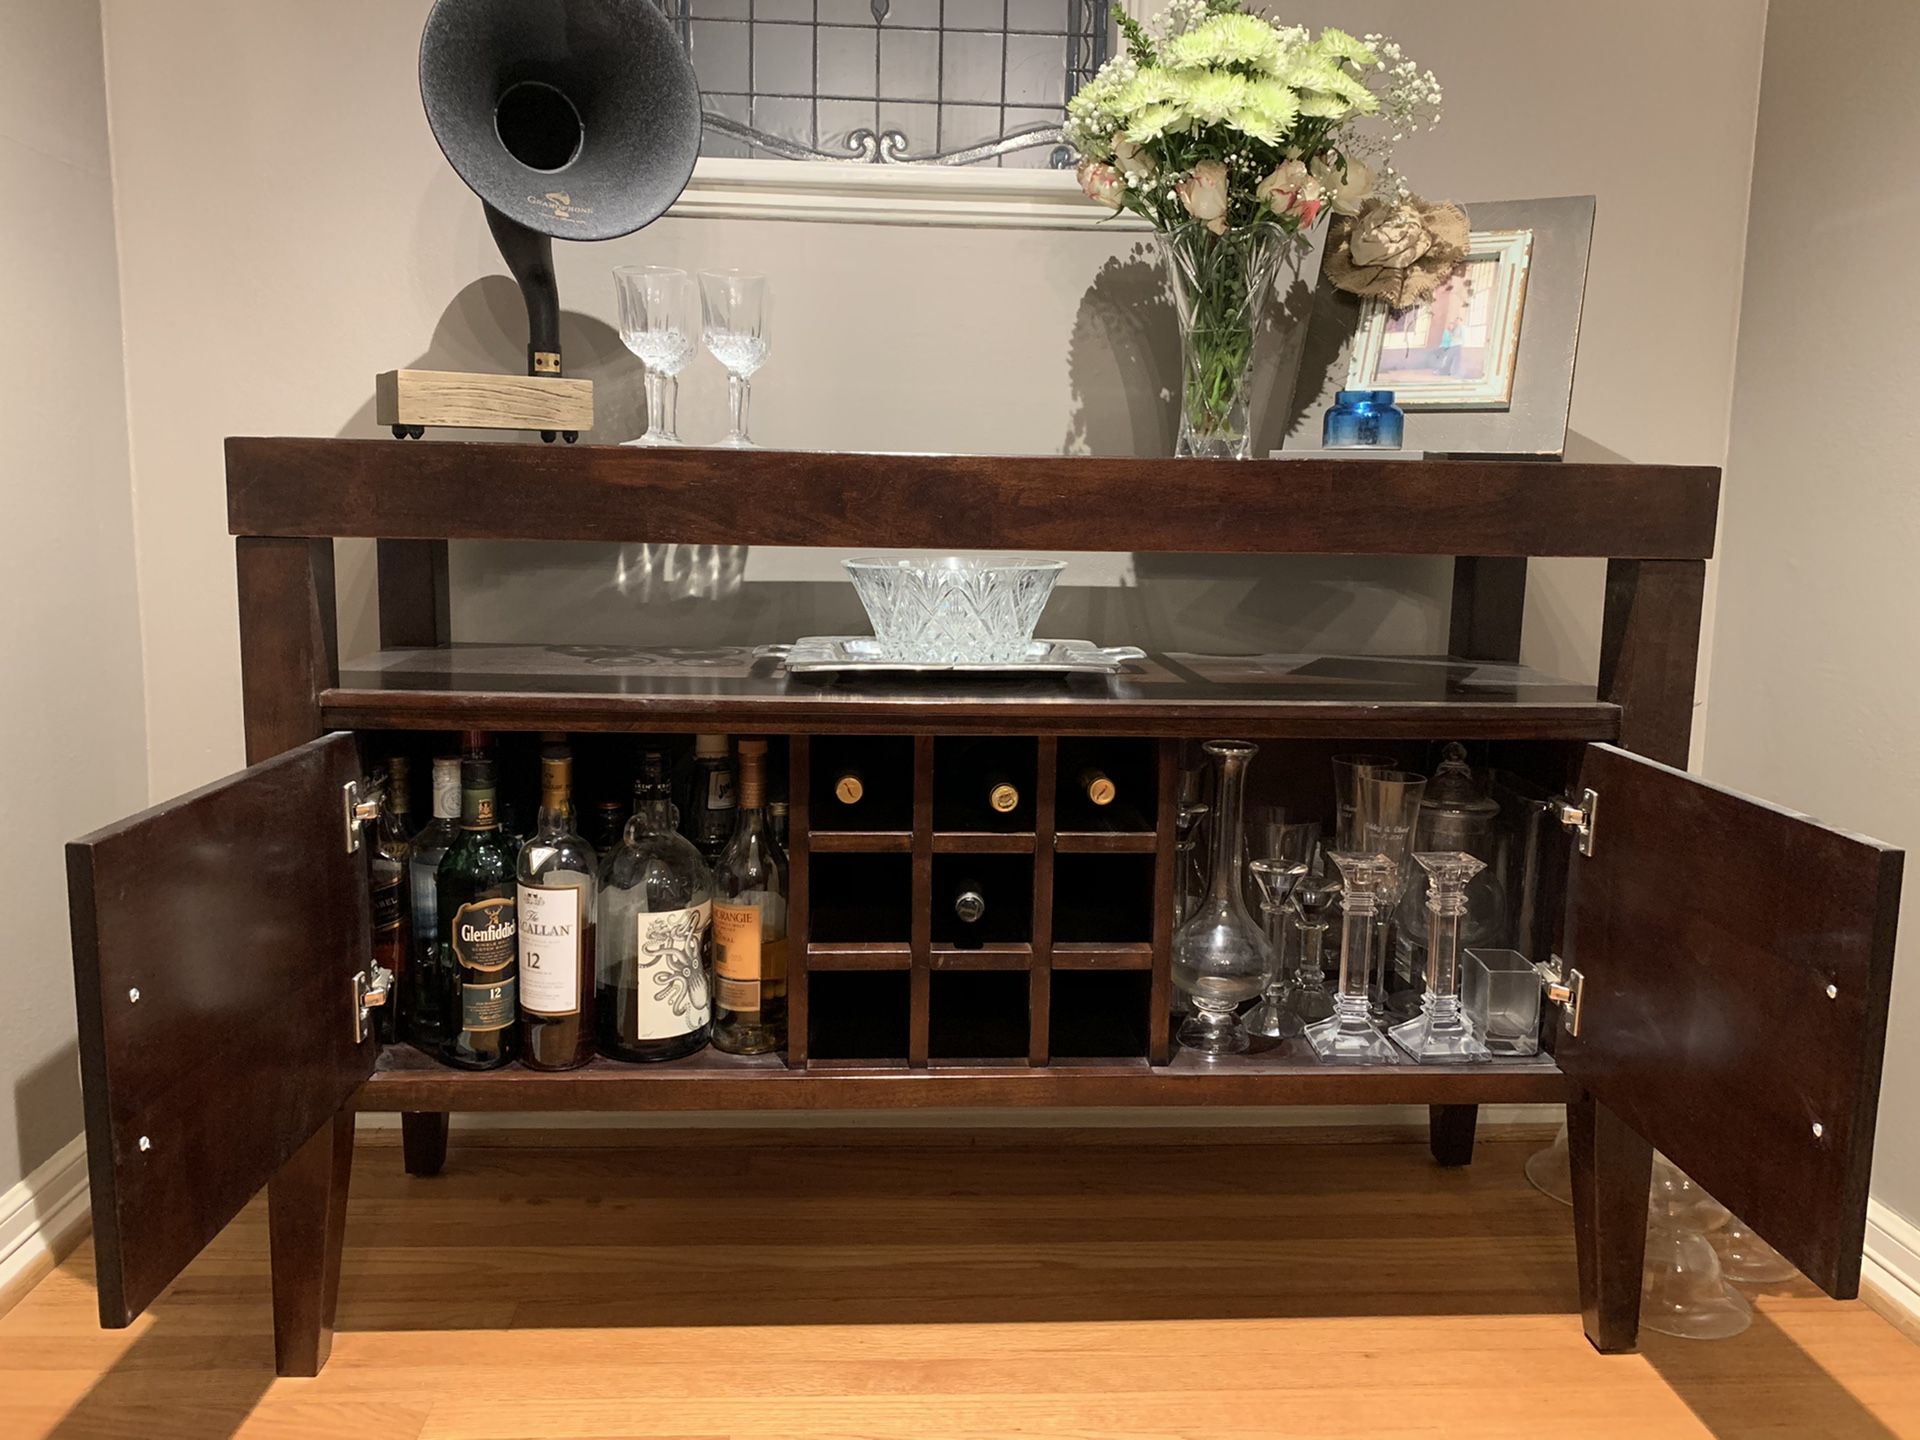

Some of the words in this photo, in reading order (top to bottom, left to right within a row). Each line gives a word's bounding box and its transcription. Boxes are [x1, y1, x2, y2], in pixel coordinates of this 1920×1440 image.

[525, 909, 539, 922] The
[519, 920, 570, 937] CALLAN
[525, 952, 541, 969] 12
[489, 987, 502, 1000] 12
